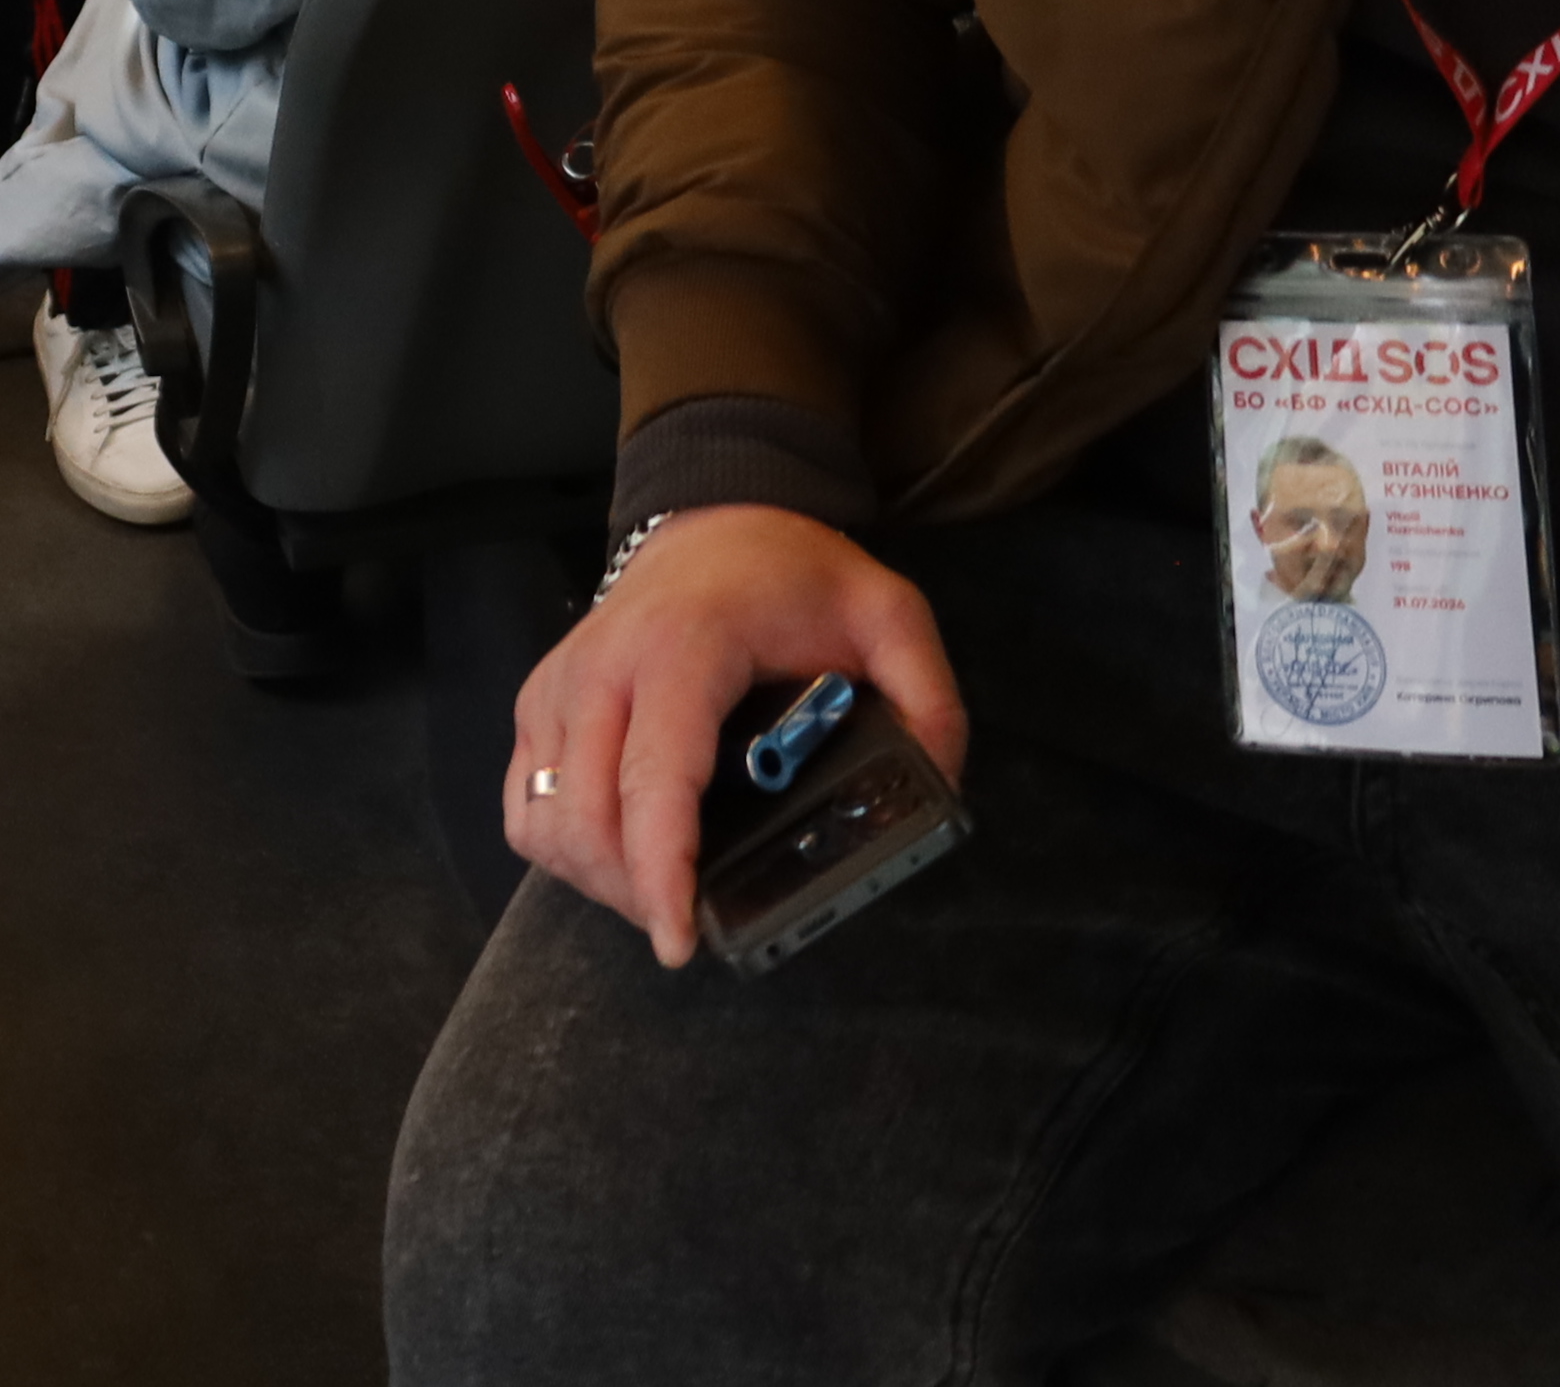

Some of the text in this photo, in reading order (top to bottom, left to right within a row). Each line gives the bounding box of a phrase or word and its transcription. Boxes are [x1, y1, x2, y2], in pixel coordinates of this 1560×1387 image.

[1229, 336, 1500, 386] СХІД SOS
[1233, 391, 1265, 411] БО
[1382, 457, 1460, 478] ВІТАЛІЙ
[1384, 482, 1510, 501] КУЗНІЧЕНКО
